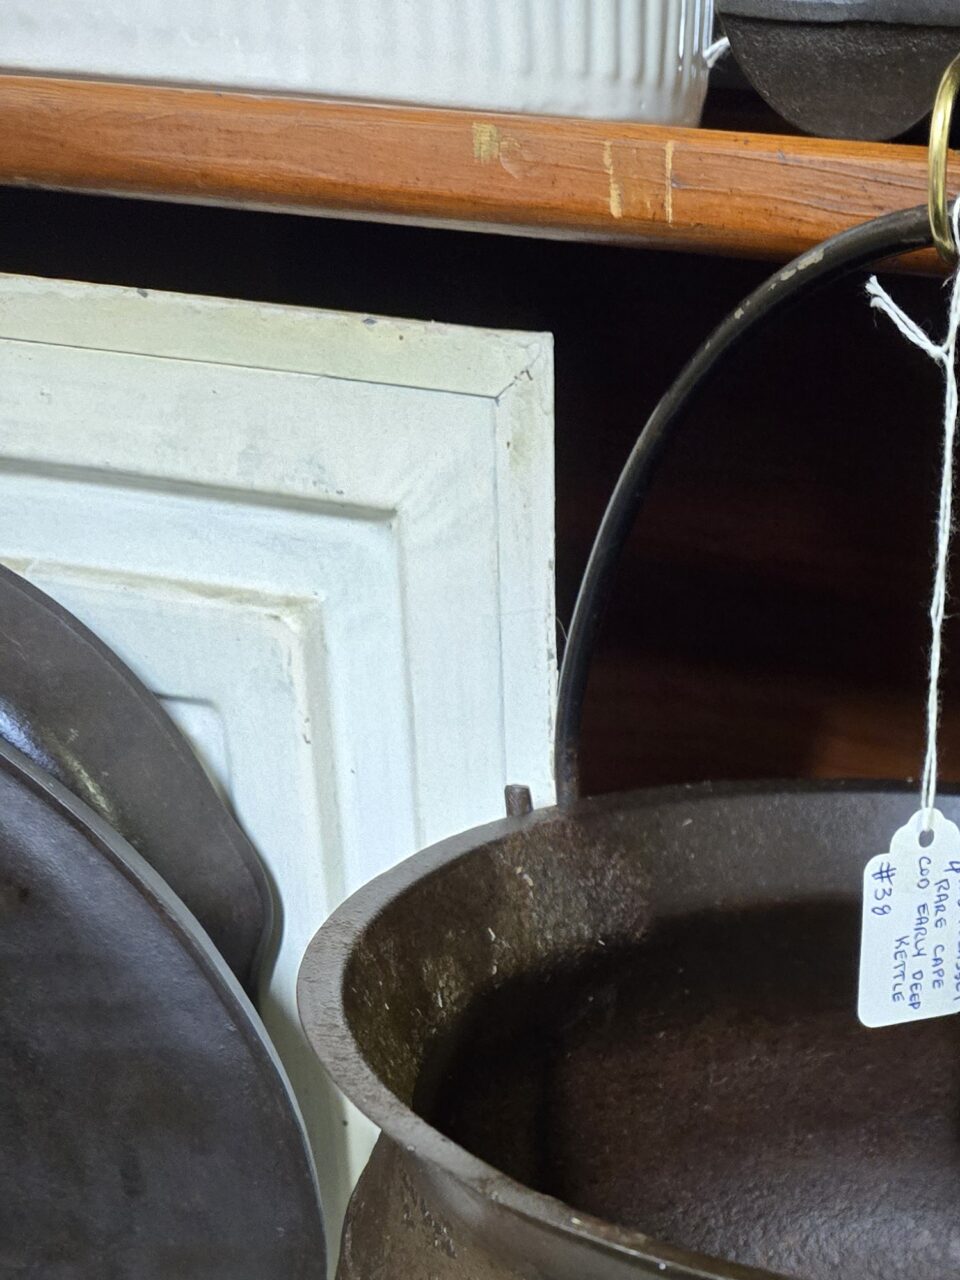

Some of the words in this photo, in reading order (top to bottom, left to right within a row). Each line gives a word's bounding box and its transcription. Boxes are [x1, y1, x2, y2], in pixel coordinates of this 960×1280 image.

[916, 856, 932, 889] COD
[934, 878, 951, 929] RARE
[911, 903, 930, 958] EARLY
[892, 935, 910, 1003] KETTLE
[908, 970, 924, 1010] DEEP
[931, 945, 946, 989] CAPE
